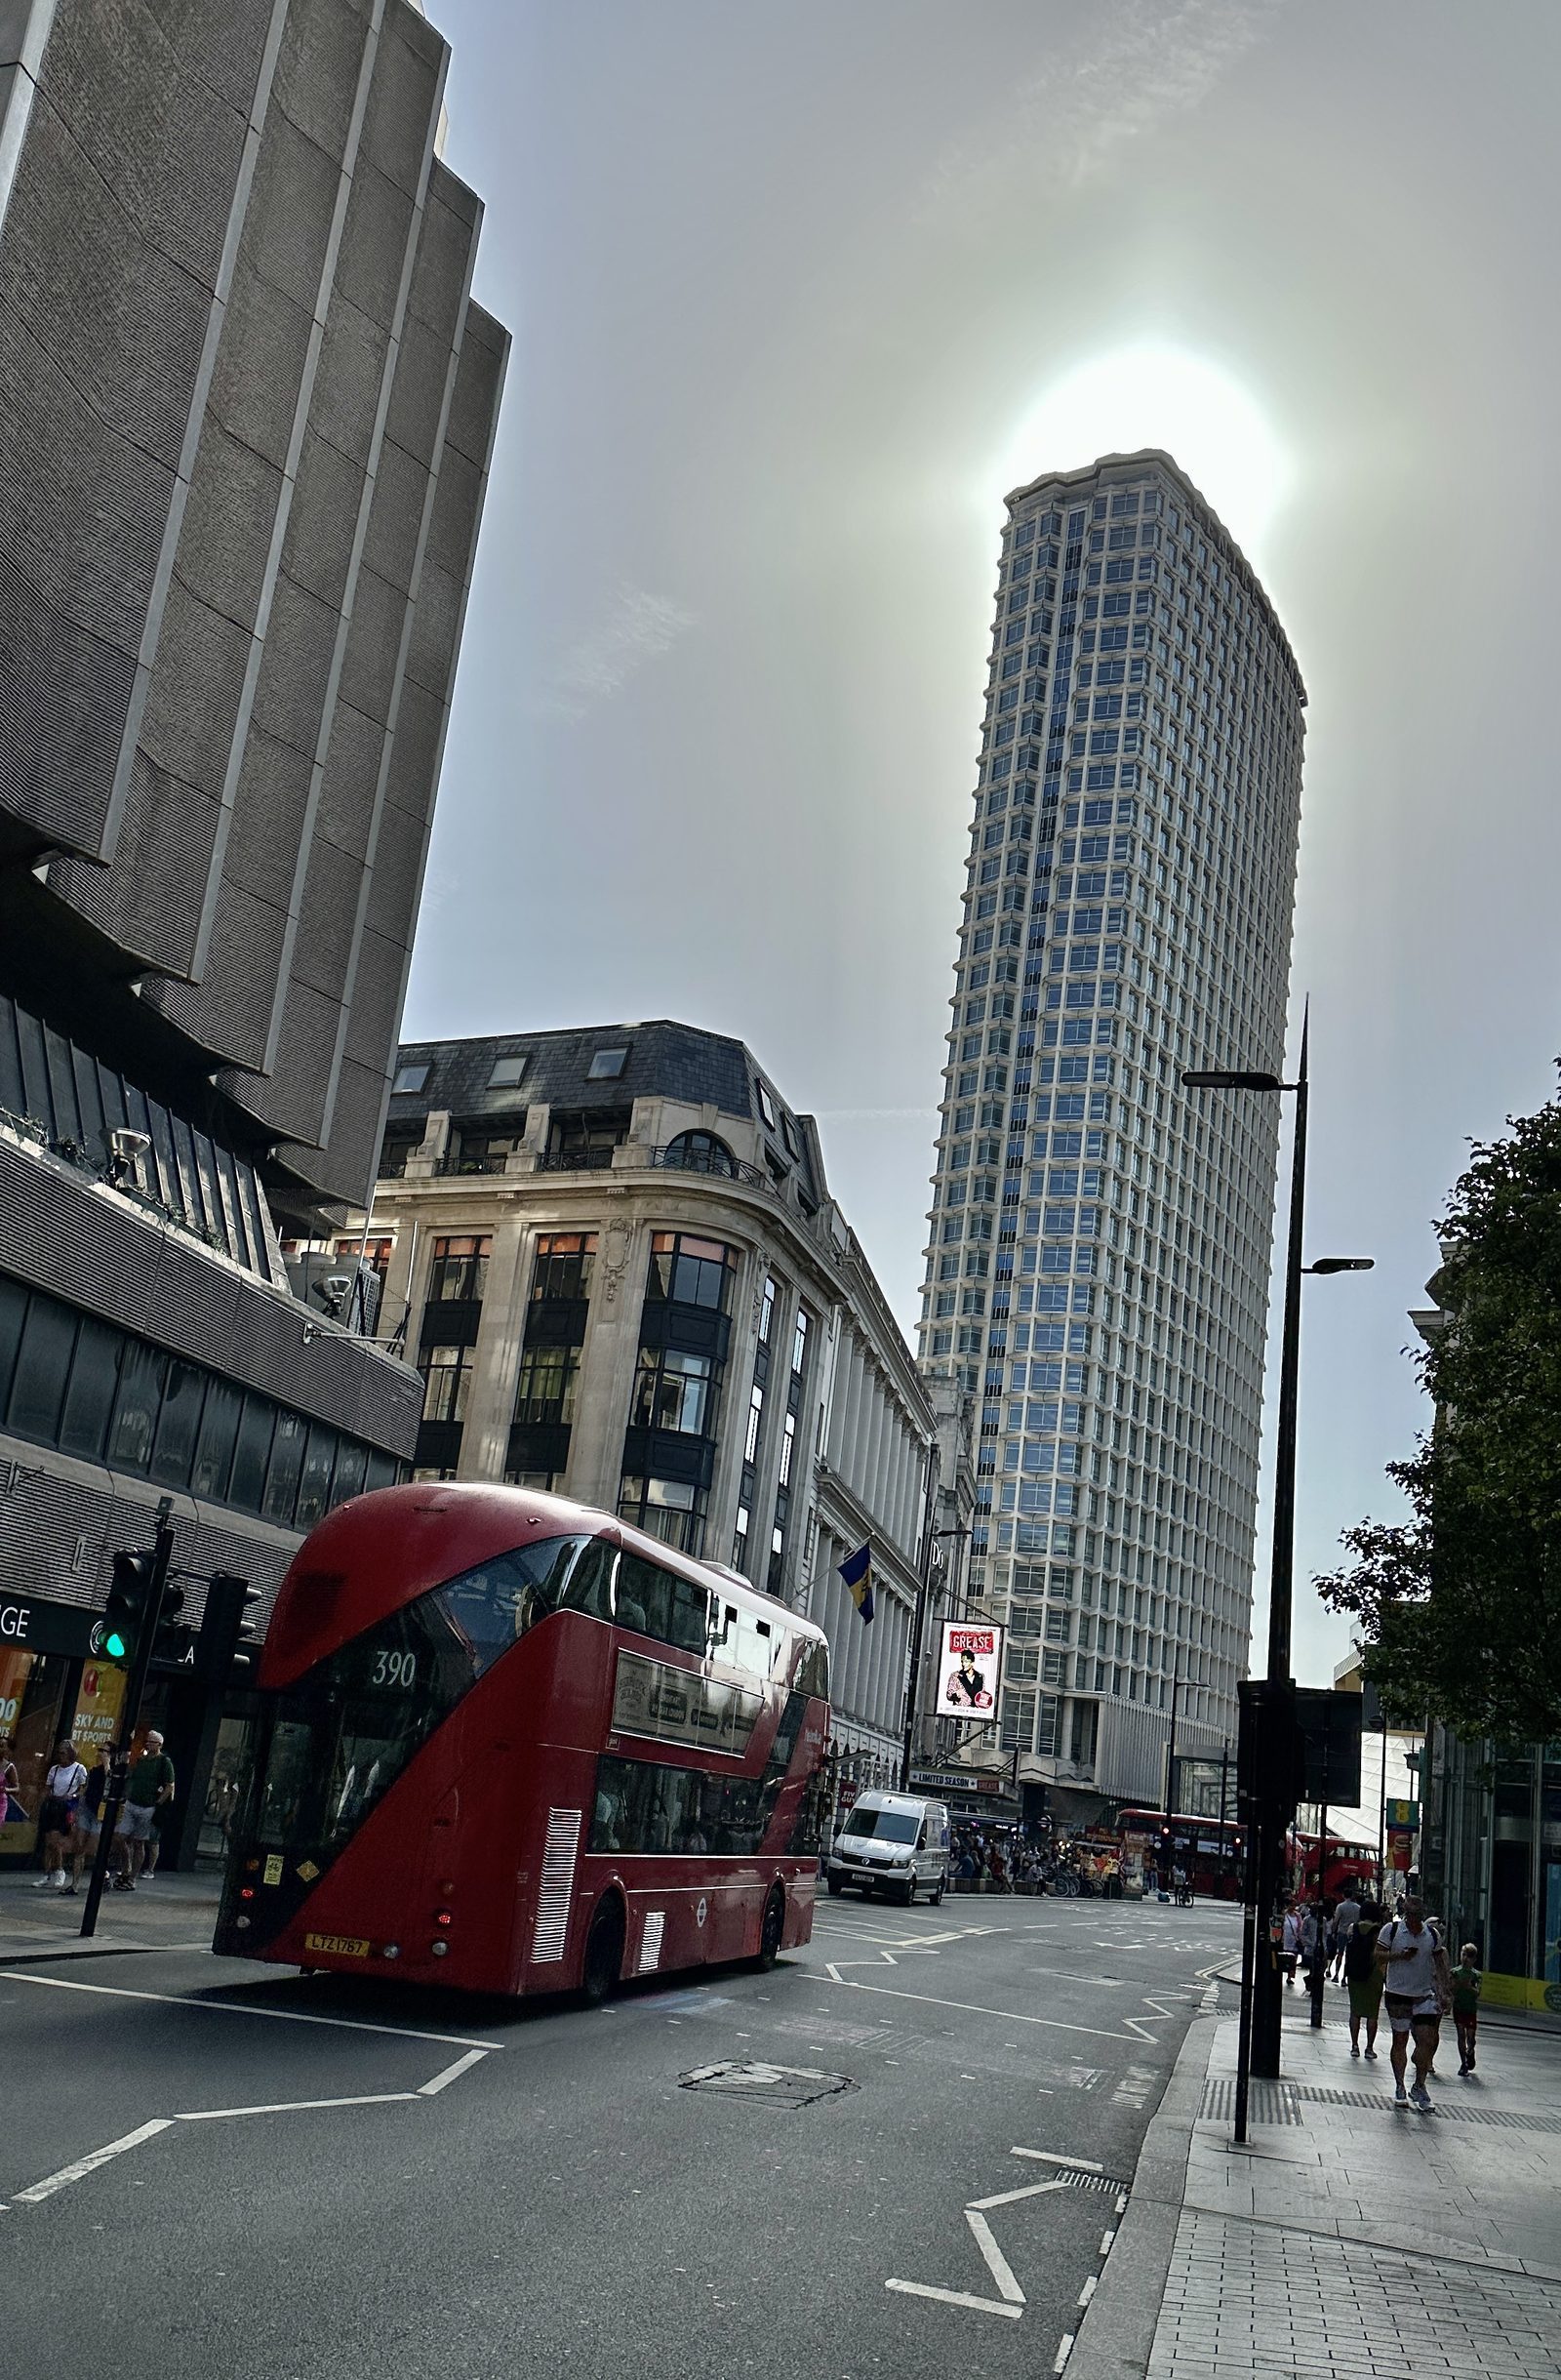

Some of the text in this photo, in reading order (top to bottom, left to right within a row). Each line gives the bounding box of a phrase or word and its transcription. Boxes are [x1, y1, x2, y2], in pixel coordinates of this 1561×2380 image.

[0, 1605, 30, 1637] GE
[952, 1634, 992, 1649] GREASE
[372, 1650, 417, 1687] 390
[75, 1714, 114, 1729] SKY AND
[71, 1728, 112, 1743] BT SPORTS
[919, 1773, 943, 1785] LIMITED
[944, 1776, 969, 1788] SEASON
